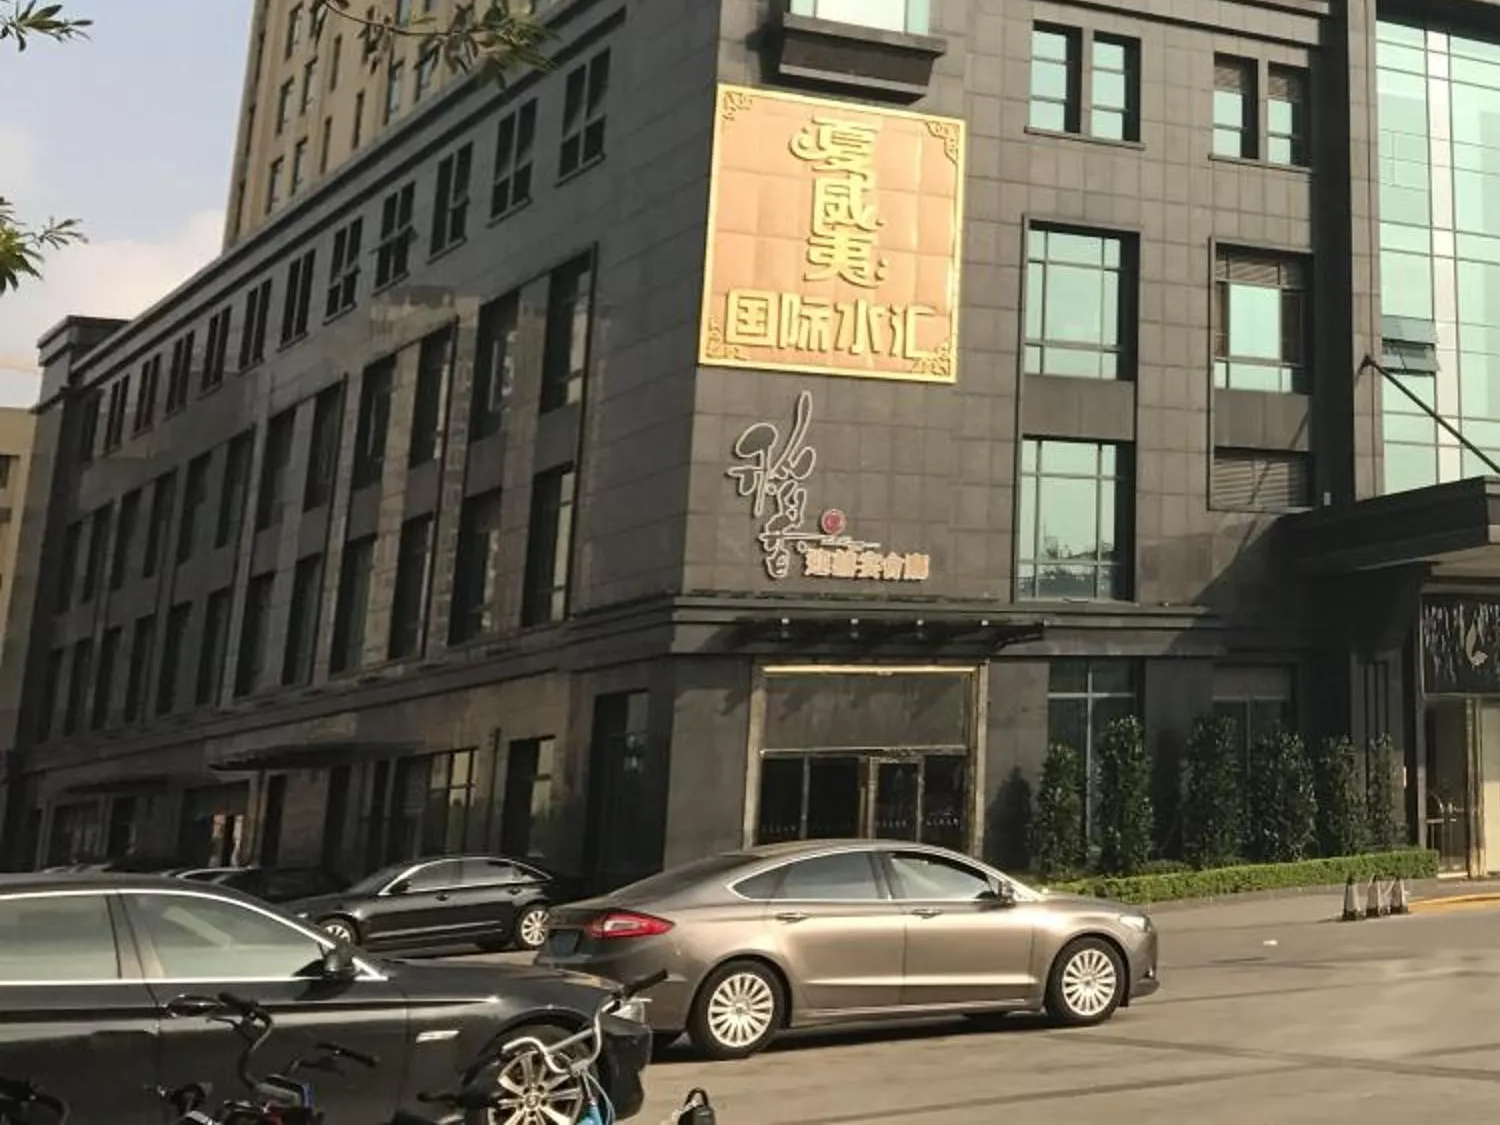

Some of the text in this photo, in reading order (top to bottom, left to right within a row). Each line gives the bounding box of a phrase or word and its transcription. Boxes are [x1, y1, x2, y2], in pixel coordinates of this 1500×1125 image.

[788, 114, 888, 289] 夏威夷
[726, 288, 938, 361] 国际水汇
